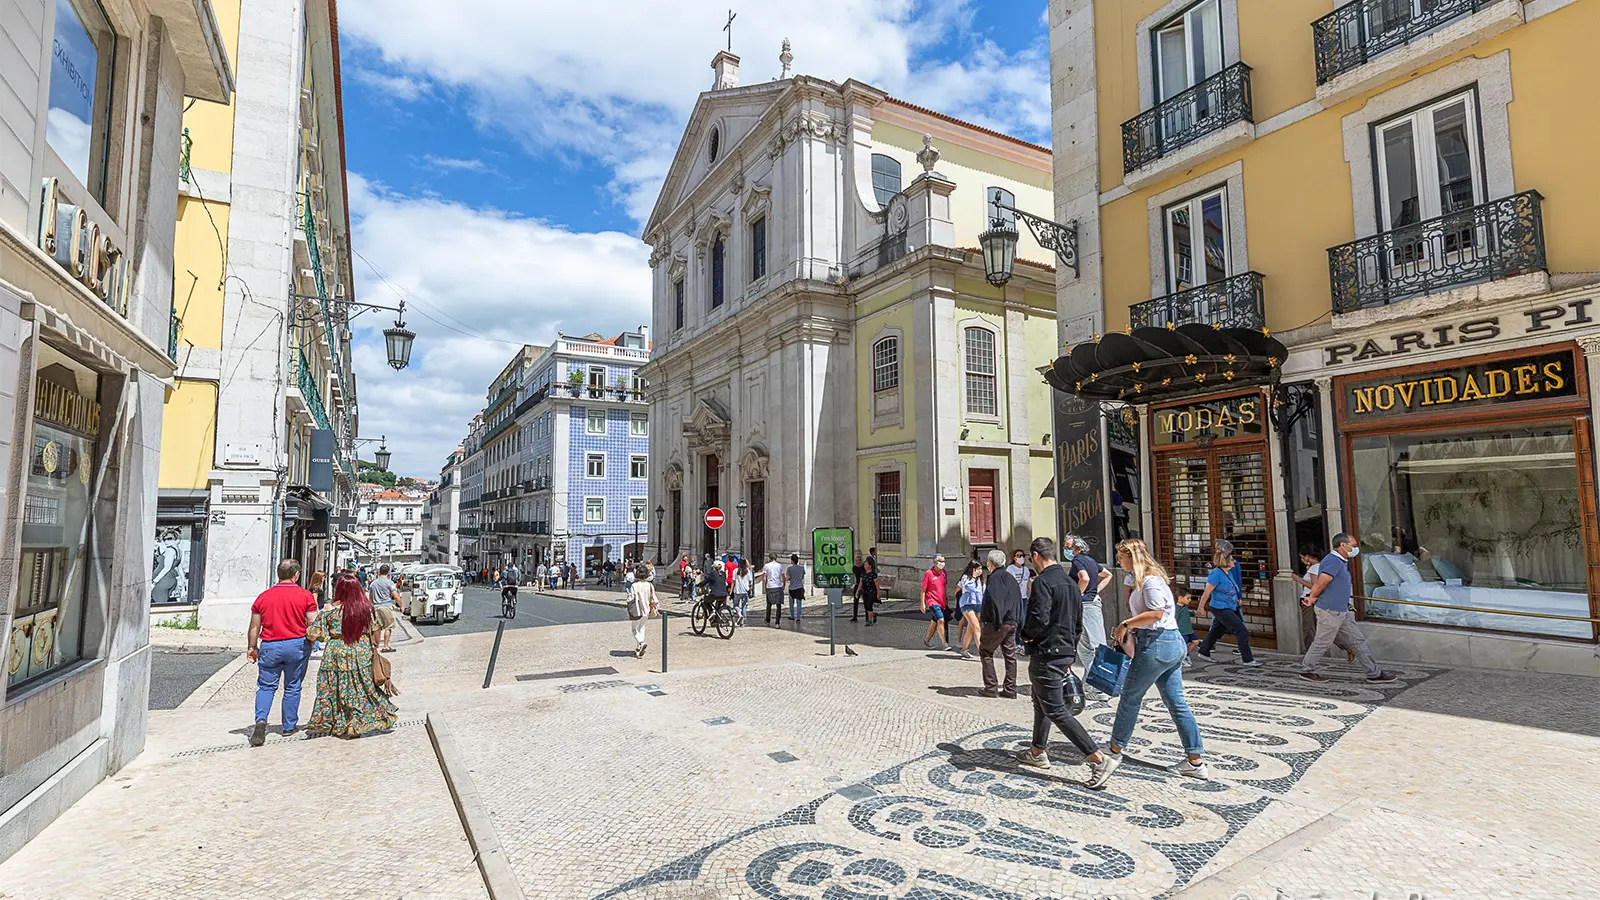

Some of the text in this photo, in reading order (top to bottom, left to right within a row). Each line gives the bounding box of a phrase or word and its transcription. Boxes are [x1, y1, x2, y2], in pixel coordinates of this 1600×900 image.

[1324, 316, 1500, 366] PARIS
[1353, 361, 1564, 414] NOVIDADES
[1158, 401, 1255, 434] MODAS
[1058, 428, 1099, 485] PARIS
[822, 557, 846, 566] ADO
